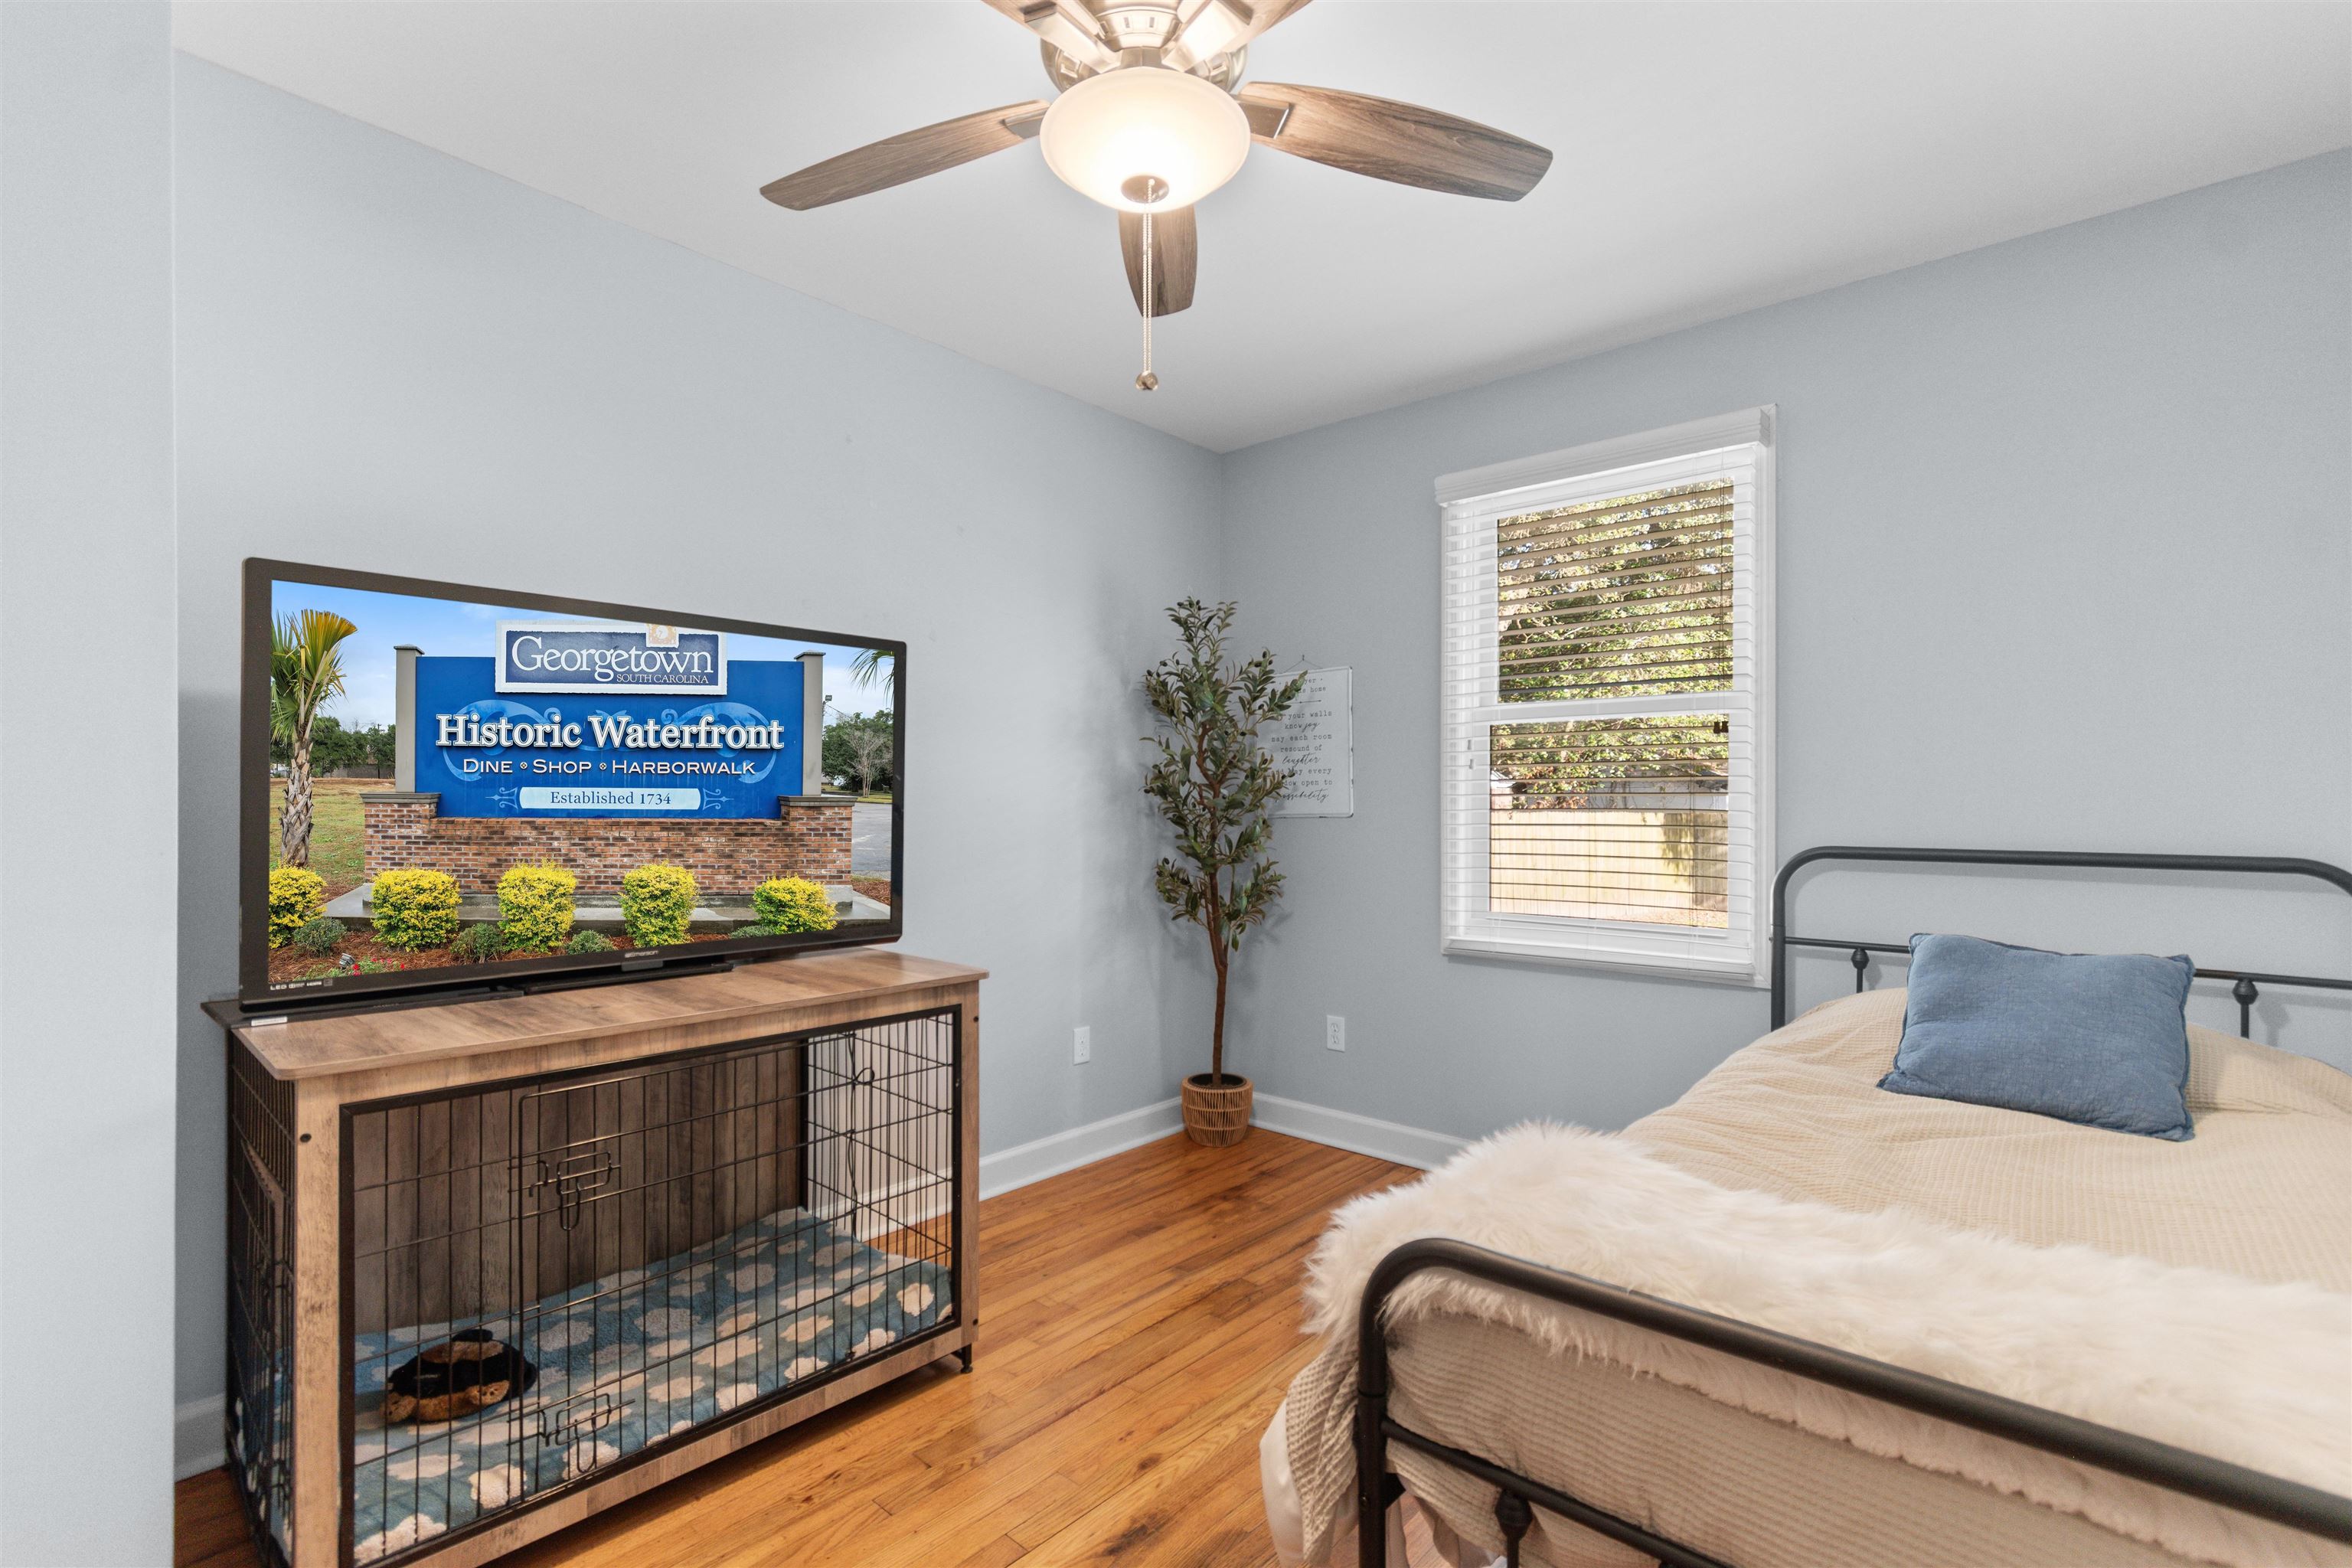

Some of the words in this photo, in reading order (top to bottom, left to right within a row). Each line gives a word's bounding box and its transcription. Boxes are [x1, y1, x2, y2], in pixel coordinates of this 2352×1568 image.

[512, 636, 714, 681] Georgetown
[616, 674, 652, 682] SOUTH
[654, 675, 709, 684] CAROLINA
[436, 713, 583, 748] Historic
[588, 714, 785, 749] Waterfront
[1280, 744, 1310, 753] resound
[463, 759, 513, 773] DINE
[533, 759, 592, 774] SHOP
[612, 760, 756, 775] HARBORWALK
[1282, 753, 1321, 767] laughter
[550, 791, 634, 805] Established
[639, 792, 671, 805] 1734
[1278, 788, 1329, 803] ossibility
